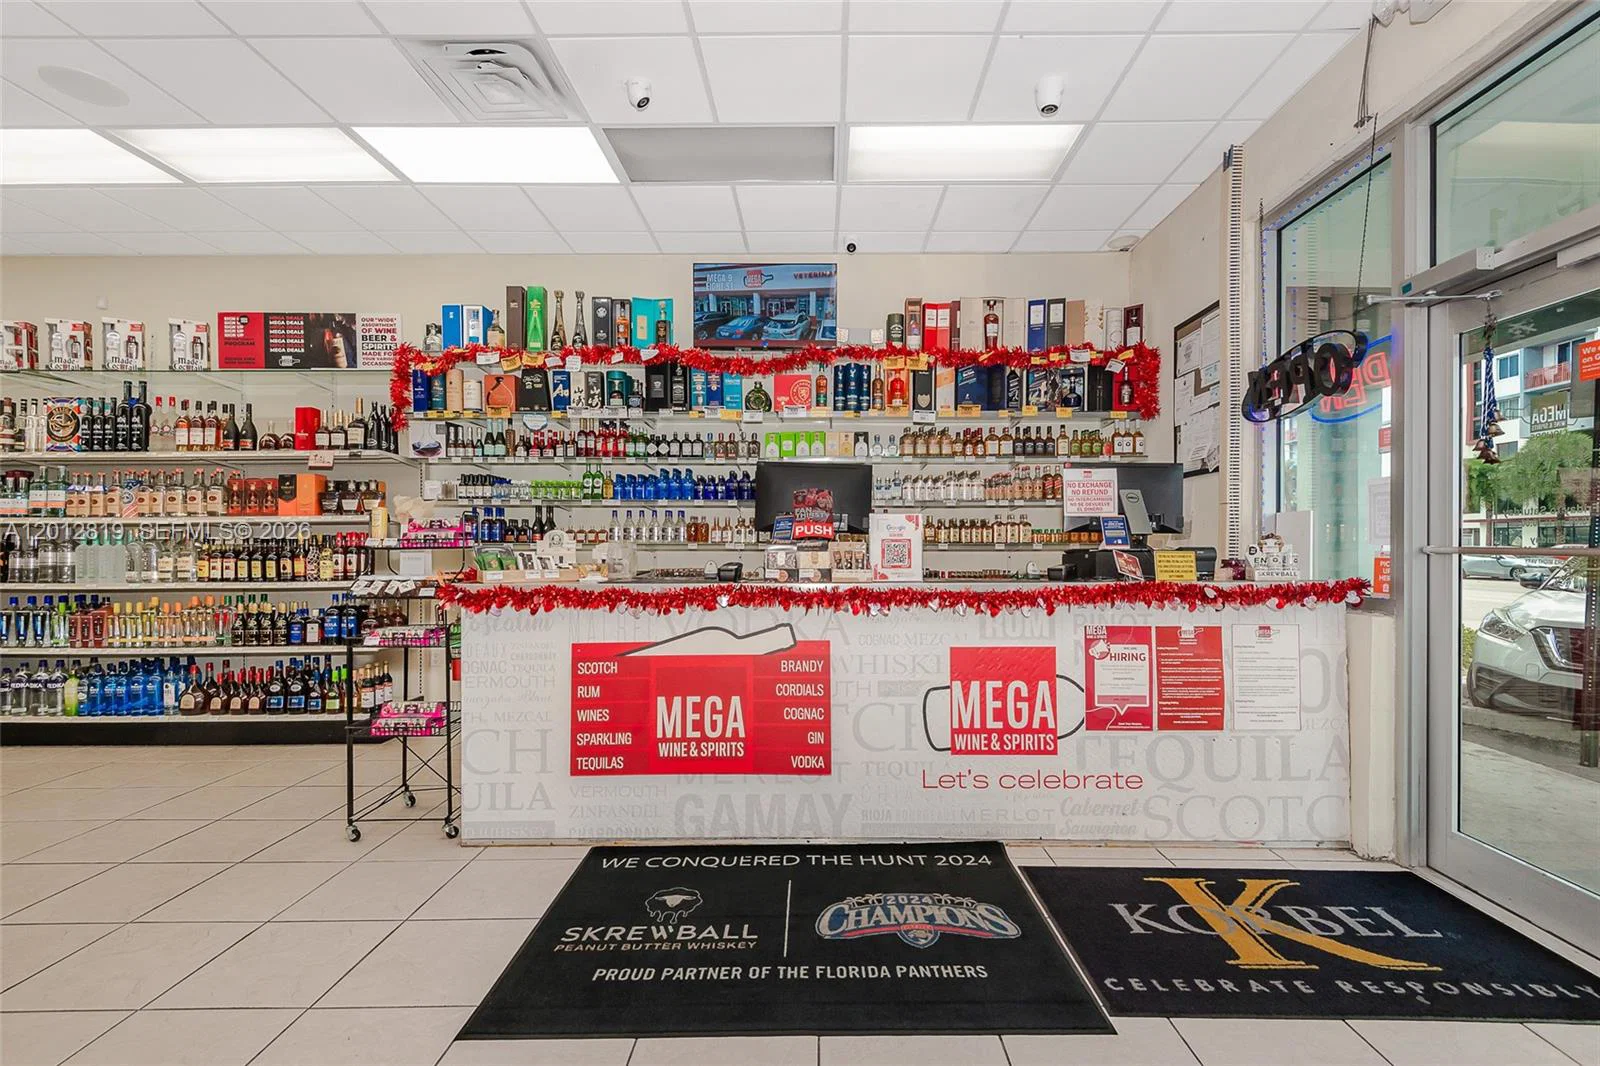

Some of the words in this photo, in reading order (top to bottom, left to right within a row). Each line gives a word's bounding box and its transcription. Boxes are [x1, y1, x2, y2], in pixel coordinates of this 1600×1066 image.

[796, 525, 832, 536] PUSH
[1110, 653, 1146, 661] HIRING
[577, 662, 618, 675] SCOTCH
[781, 660, 824, 672] BRANDY
[577, 686, 600, 698] RUM
[776, 684, 824, 696] CORDIALS
[952, 680, 1055, 729] MEGA
[577, 709, 609, 722] WINES
[656, 696, 746, 738] MEGA
[783, 708, 824, 720] COGNAC
[576, 732, 632, 746] SPARKLING
[807, 732, 824, 744] GIN
[954, 734, 988, 750] WINE
[991, 734, 1000, 750] &
[1004, 734, 1054, 750] SPIRITS
[658, 742, 687, 757] WINE
[690, 742, 698, 756] &
[700, 742, 744, 756] SPIRITS
[577, 756, 624, 770] TEQUILAS
[791, 756, 825, 768] VODKA
[922, 769, 989, 789] Let's
[999, 769, 1143, 789] celebrate
[674, 793, 854, 838] GAMAY
[602, 858, 640, 868] WE
[645, 855, 800, 868] CONQUERED
[806, 855, 853, 866] THE
[860, 855, 927, 866] HUNT
[934, 855, 992, 866] 2024
[886, 896, 934, 905] 2024
[818, 903, 1020, 936] CHAMPIONS
[1108, 903, 1444, 938] KORBEL
[561, 924, 758, 941] SKREWBALL
[554, 942, 617, 952] PEANUT
[621, 942, 681, 950] BUTTER
[687, 941, 757, 950] WHISKEY
[592, 968, 656, 981] PROUD
[661, 966, 742, 980] PARTNER
[749, 966, 772, 979] OF
[778, 966, 809, 978] THE
[816, 966, 891, 979] FLORIDA
[896, 966, 988, 978] PANTHERS
[1104, 978, 1315, 994] CELEBRATE
[1334, 980, 1600, 999] RESPONSIBLY
